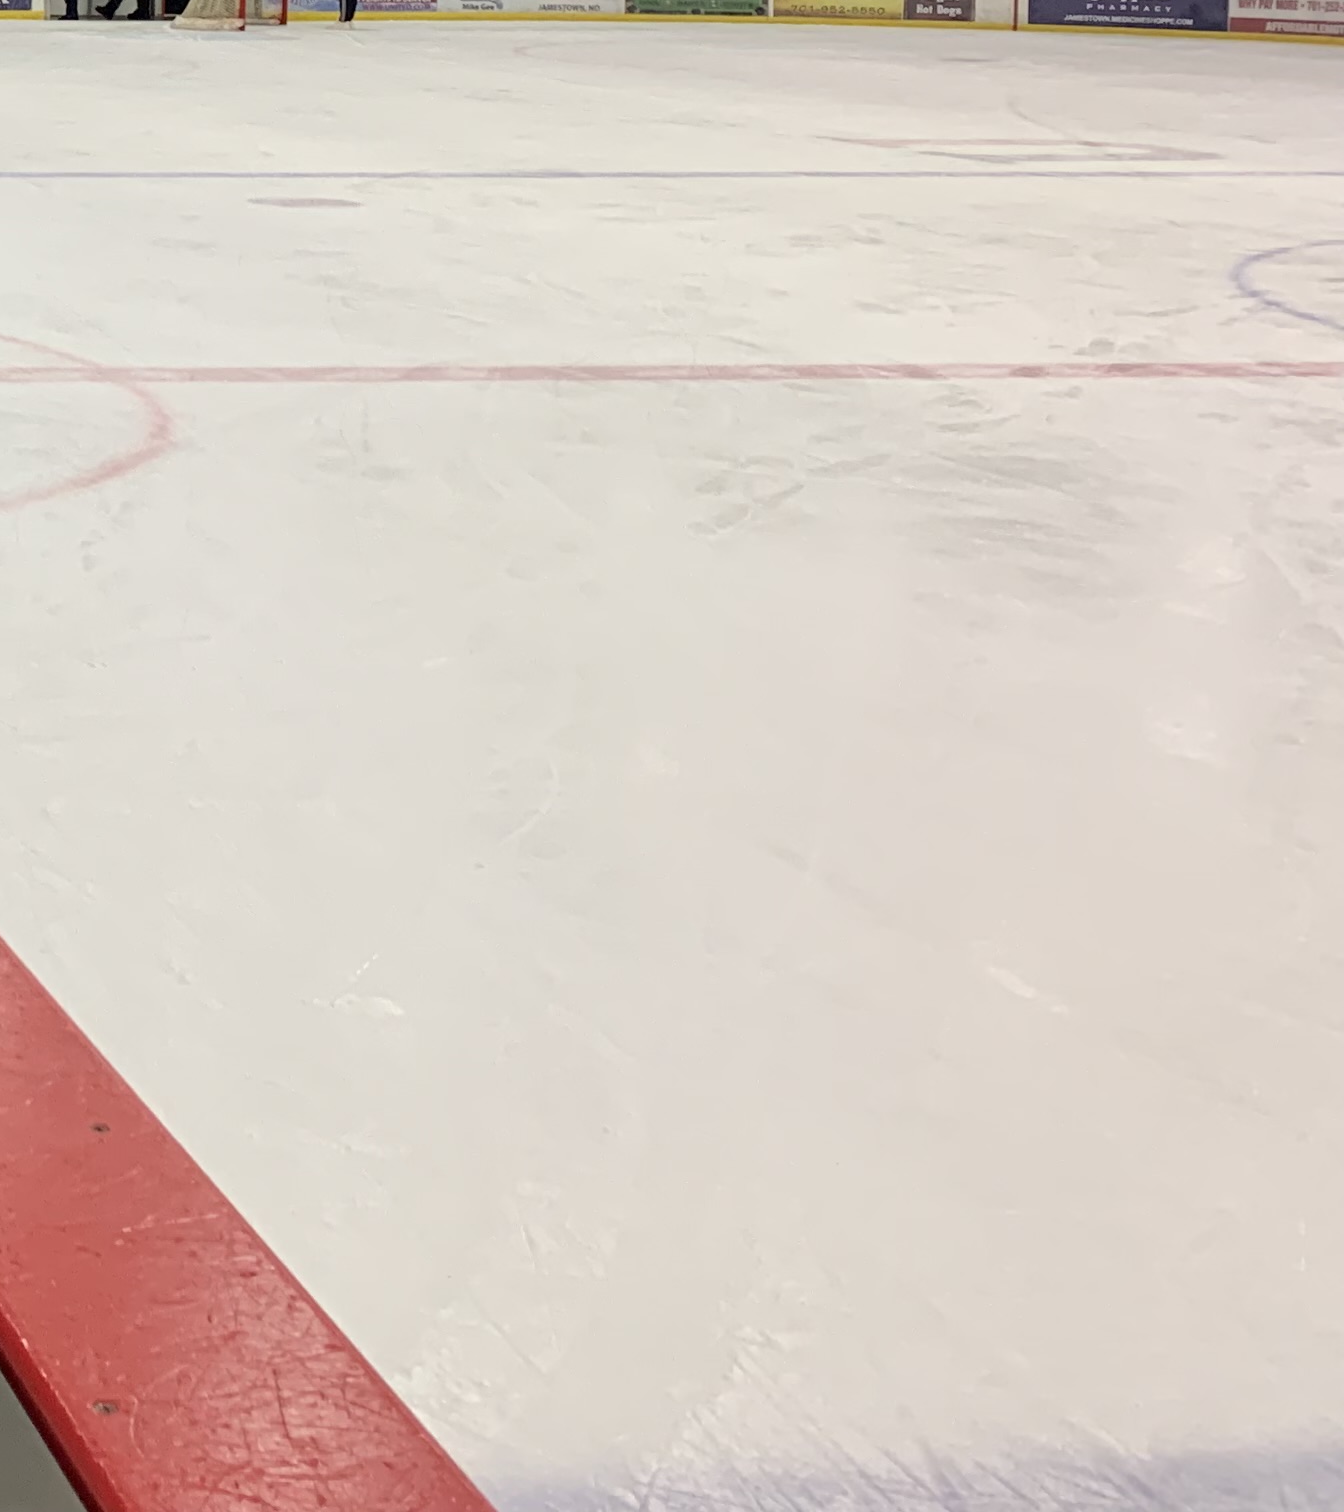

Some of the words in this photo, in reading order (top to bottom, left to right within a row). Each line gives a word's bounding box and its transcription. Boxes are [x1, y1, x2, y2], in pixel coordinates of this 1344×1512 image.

[916, 4, 934, 15] Hot
[936, 4, 963, 18] Dogs
[1086, 4, 1172, 12] PHARMACY
